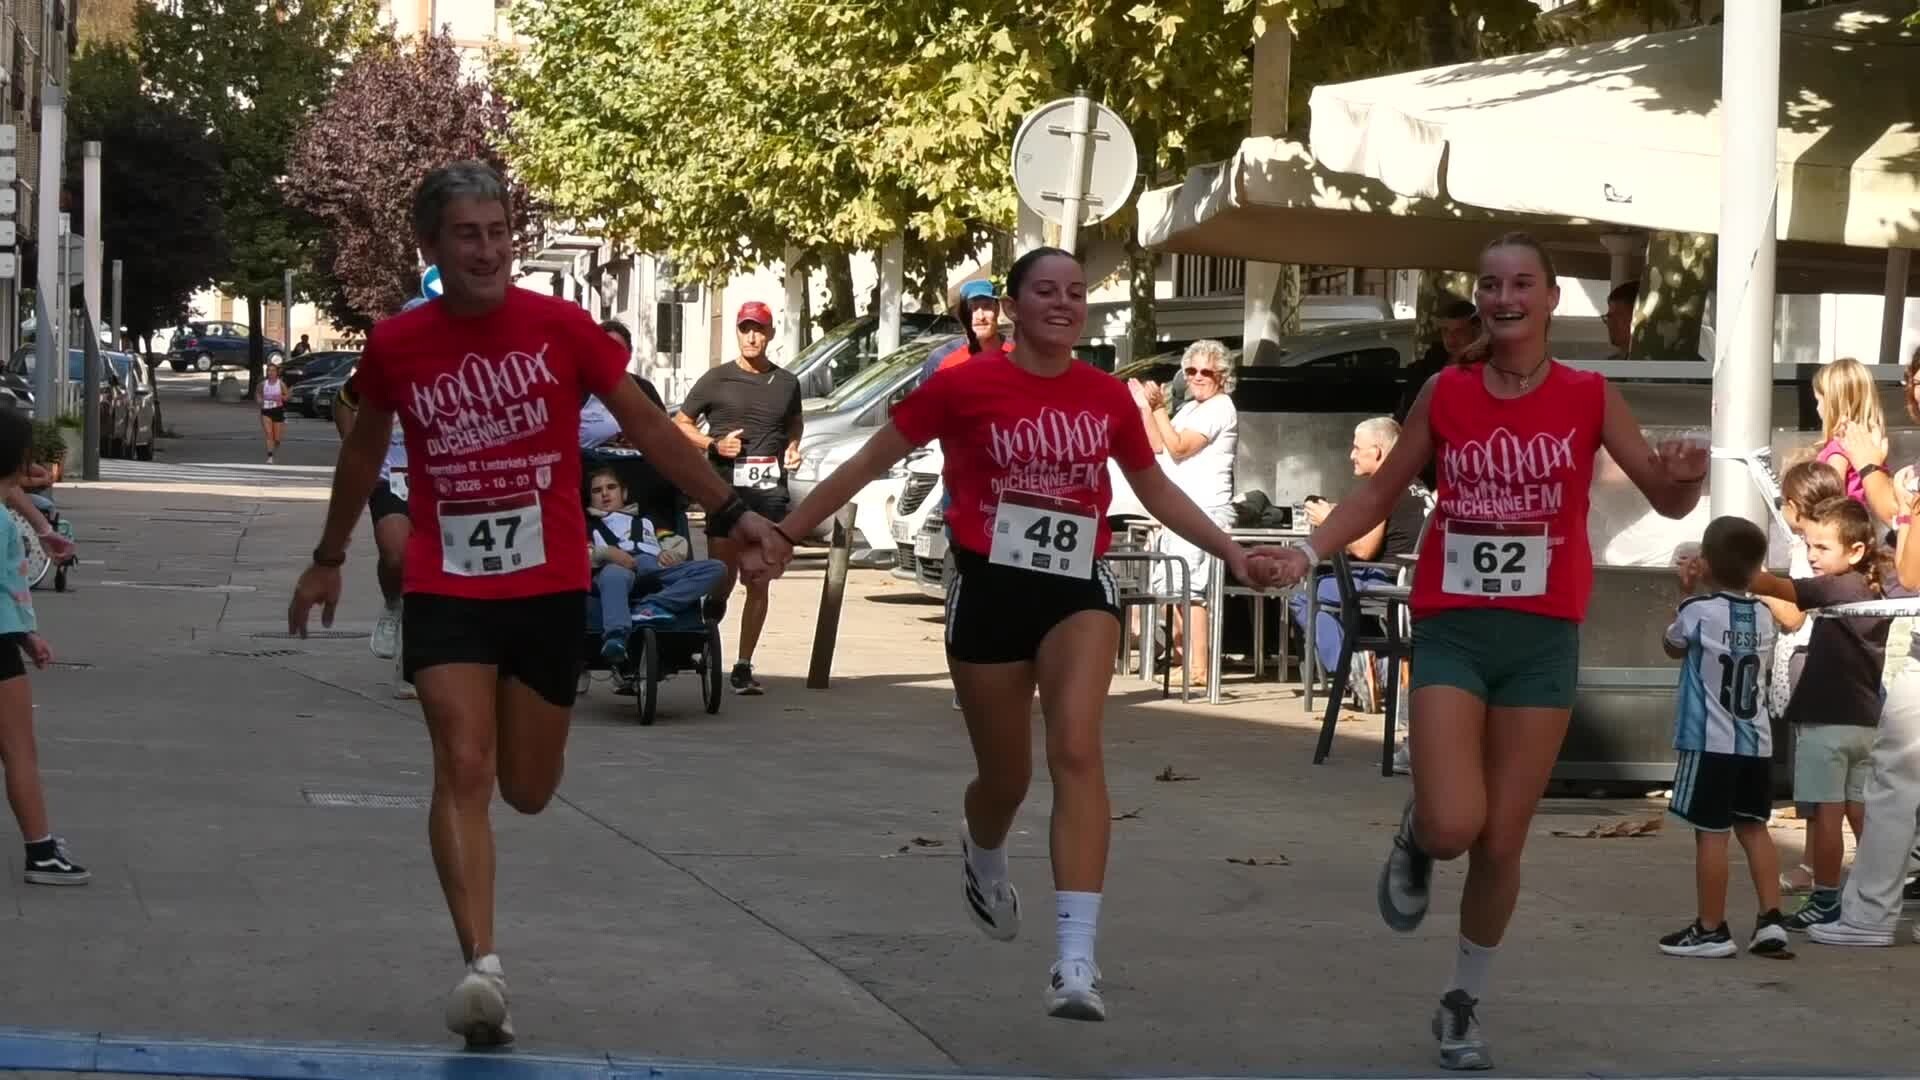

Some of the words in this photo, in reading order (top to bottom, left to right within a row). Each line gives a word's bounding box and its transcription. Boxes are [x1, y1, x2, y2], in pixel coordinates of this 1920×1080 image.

[427, 418, 510, 457] DUCHENNE
[505, 397, 549, 433] FM
[493, 476, 507, 488] 10
[748, 466, 772, 482] 84
[1441, 496, 1525, 517] DUCHENNE
[1524, 482, 1563, 511] FM
[469, 515, 522, 552] 47
[1024, 516, 1079, 553] 48
[1473, 541, 1526, 574] 62
[1722, 630, 1762, 647] MESSI
[1718, 653, 1761, 720] 10
